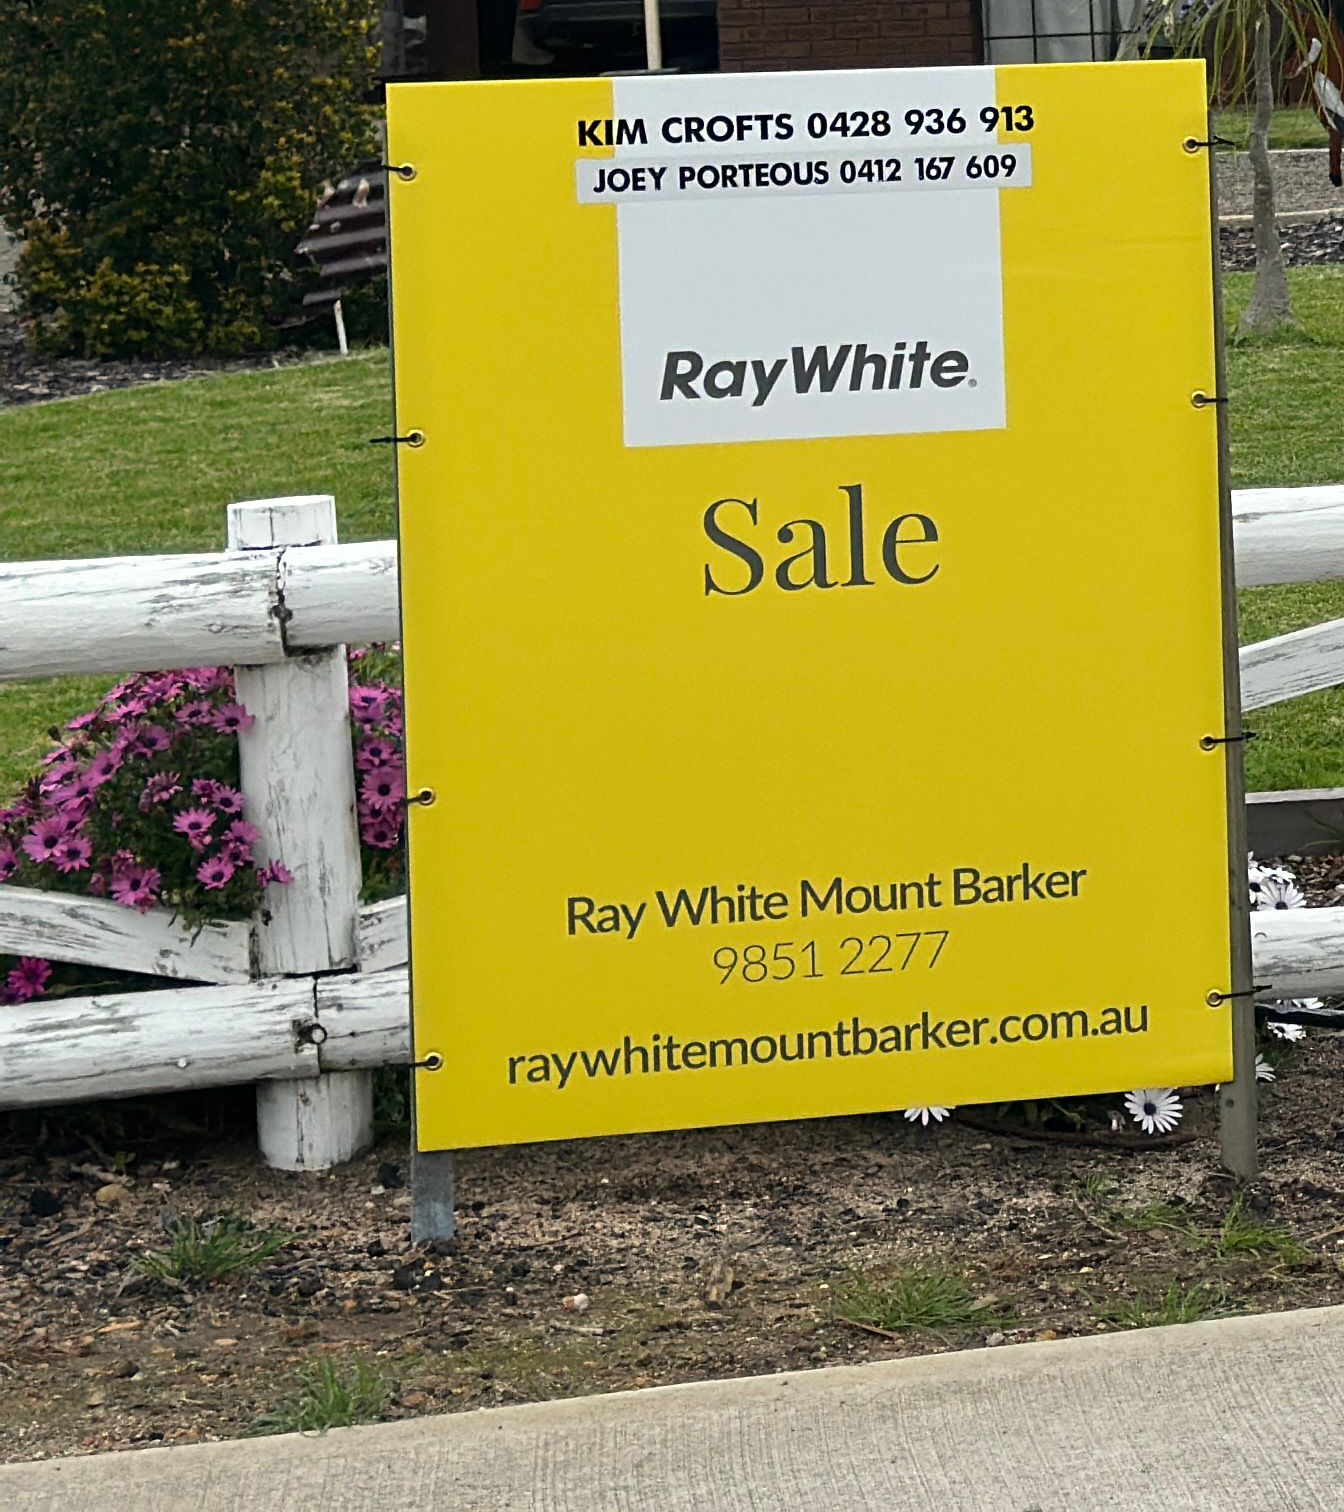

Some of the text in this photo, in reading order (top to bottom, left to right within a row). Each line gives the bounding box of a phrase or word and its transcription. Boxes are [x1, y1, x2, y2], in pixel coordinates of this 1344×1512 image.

[577, 105, 1035, 147] KIM CROFTS 0428 936 913
[592, 153, 1017, 194] JOEY PORTEOUS 0412 167 609
[703, 483, 940, 597] Sale
[567, 862, 1088, 940] Ray White Mount Barker
[713, 929, 950, 985] 9851 2277
[508, 1004, 1149, 1090] raywhitemountbarker.com.au
